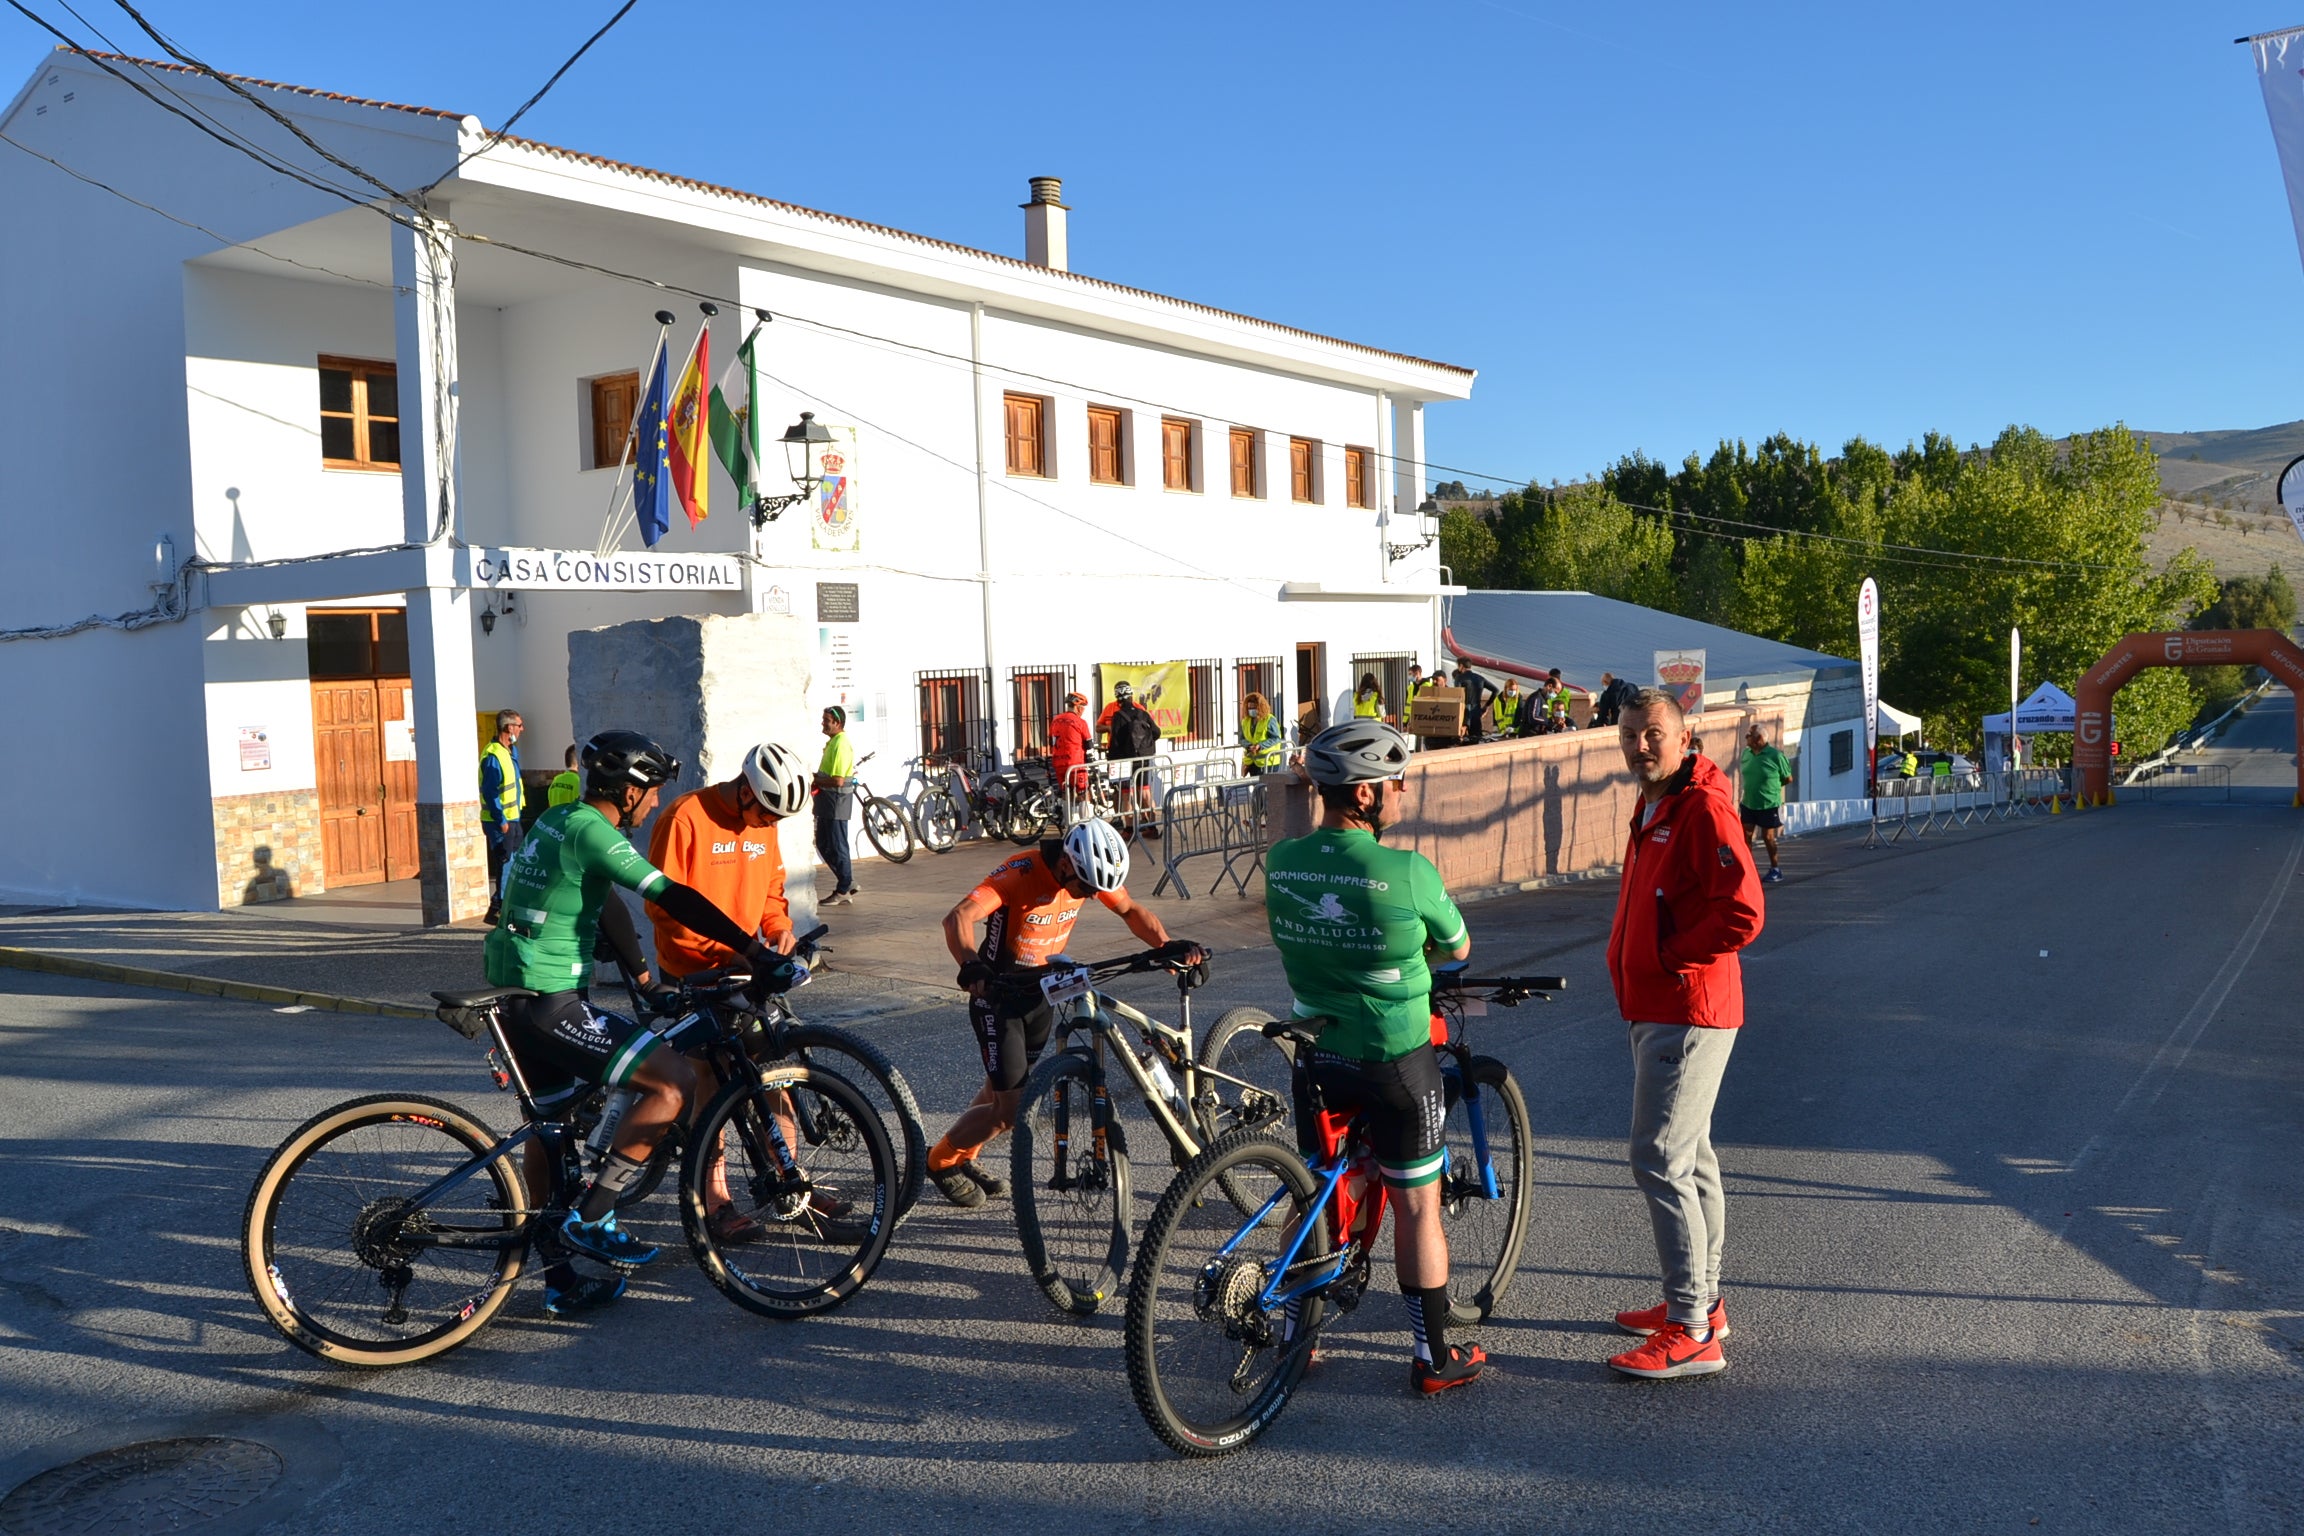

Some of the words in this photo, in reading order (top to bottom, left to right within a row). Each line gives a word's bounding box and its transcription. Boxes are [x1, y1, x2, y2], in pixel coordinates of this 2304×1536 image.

[476, 558, 548, 582] CASA
[556, 560, 734, 585] CONSISTORIAL
[2186, 637, 2231, 647] Diputación
[2194, 645, 2231, 653] Granada
[2096, 651, 2133, 685] DEPORTES
[2017, 714, 2055, 724] cruzando
[712, 841, 736, 854] Bull
[743, 841, 766, 854] Bkes
[1269, 871, 1326, 883] HORMIGON
[1330, 874, 1389, 892] IMPRESO
[1026, 913, 1052, 925] Bull
[1275, 915, 1383, 938] ANDALUCIA
[560, 1019, 612, 1045] ANDALUCIA
[985, 1014, 997, 1036] Bull
[987, 1041, 998, 1073] Bikes
[1430, 1090, 1440, 1145] ANDALUCIA
[875, 1183, 885, 1215] SWISS
[870, 1216, 881, 1236] DT
[276, 1310, 334, 1352] MAXXIS
[1262, 1393, 1285, 1421] vittoria
[1219, 1419, 1261, 1446] BARZO
